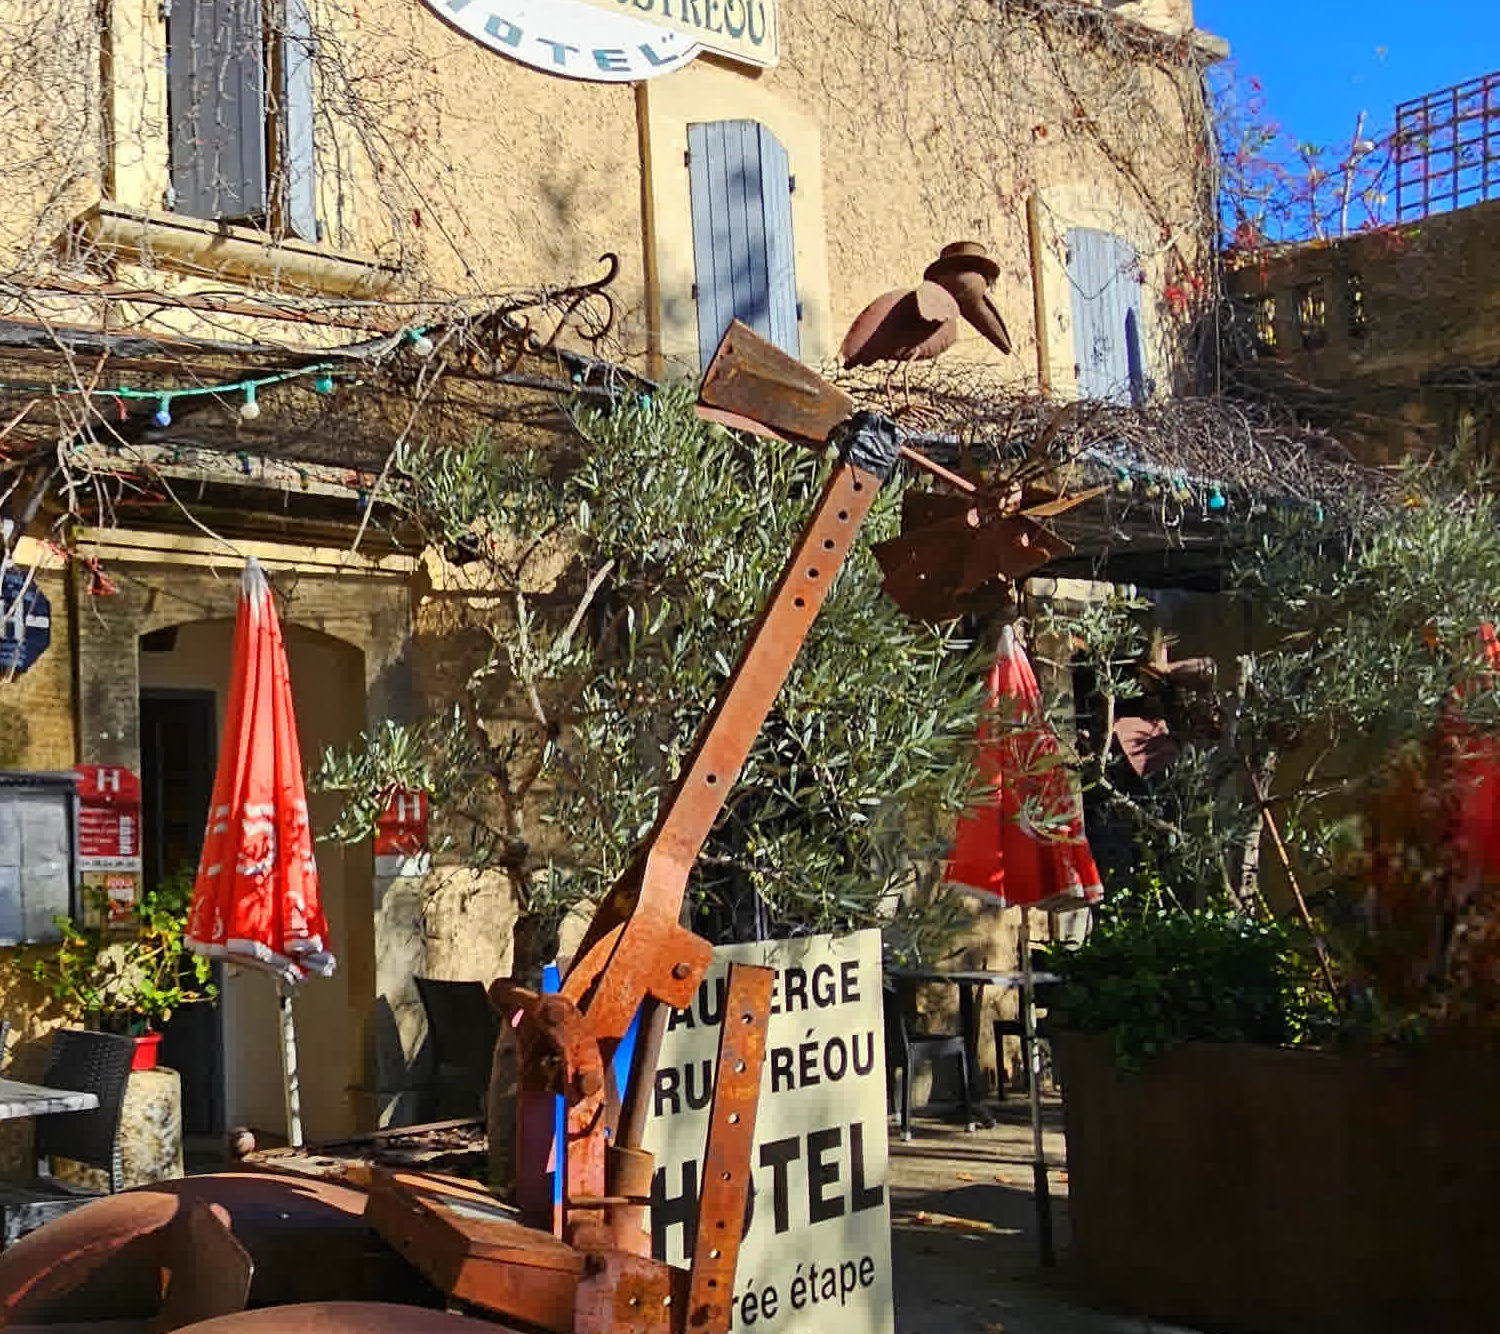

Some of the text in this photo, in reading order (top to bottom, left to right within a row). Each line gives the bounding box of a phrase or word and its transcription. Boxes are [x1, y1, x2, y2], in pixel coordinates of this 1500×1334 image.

[96, 768, 121, 793] H
[653, 1028, 874, 1117] RURÉOU
[649, 1122, 885, 1265] HTEL
[790, 1254, 876, 1307] étape
